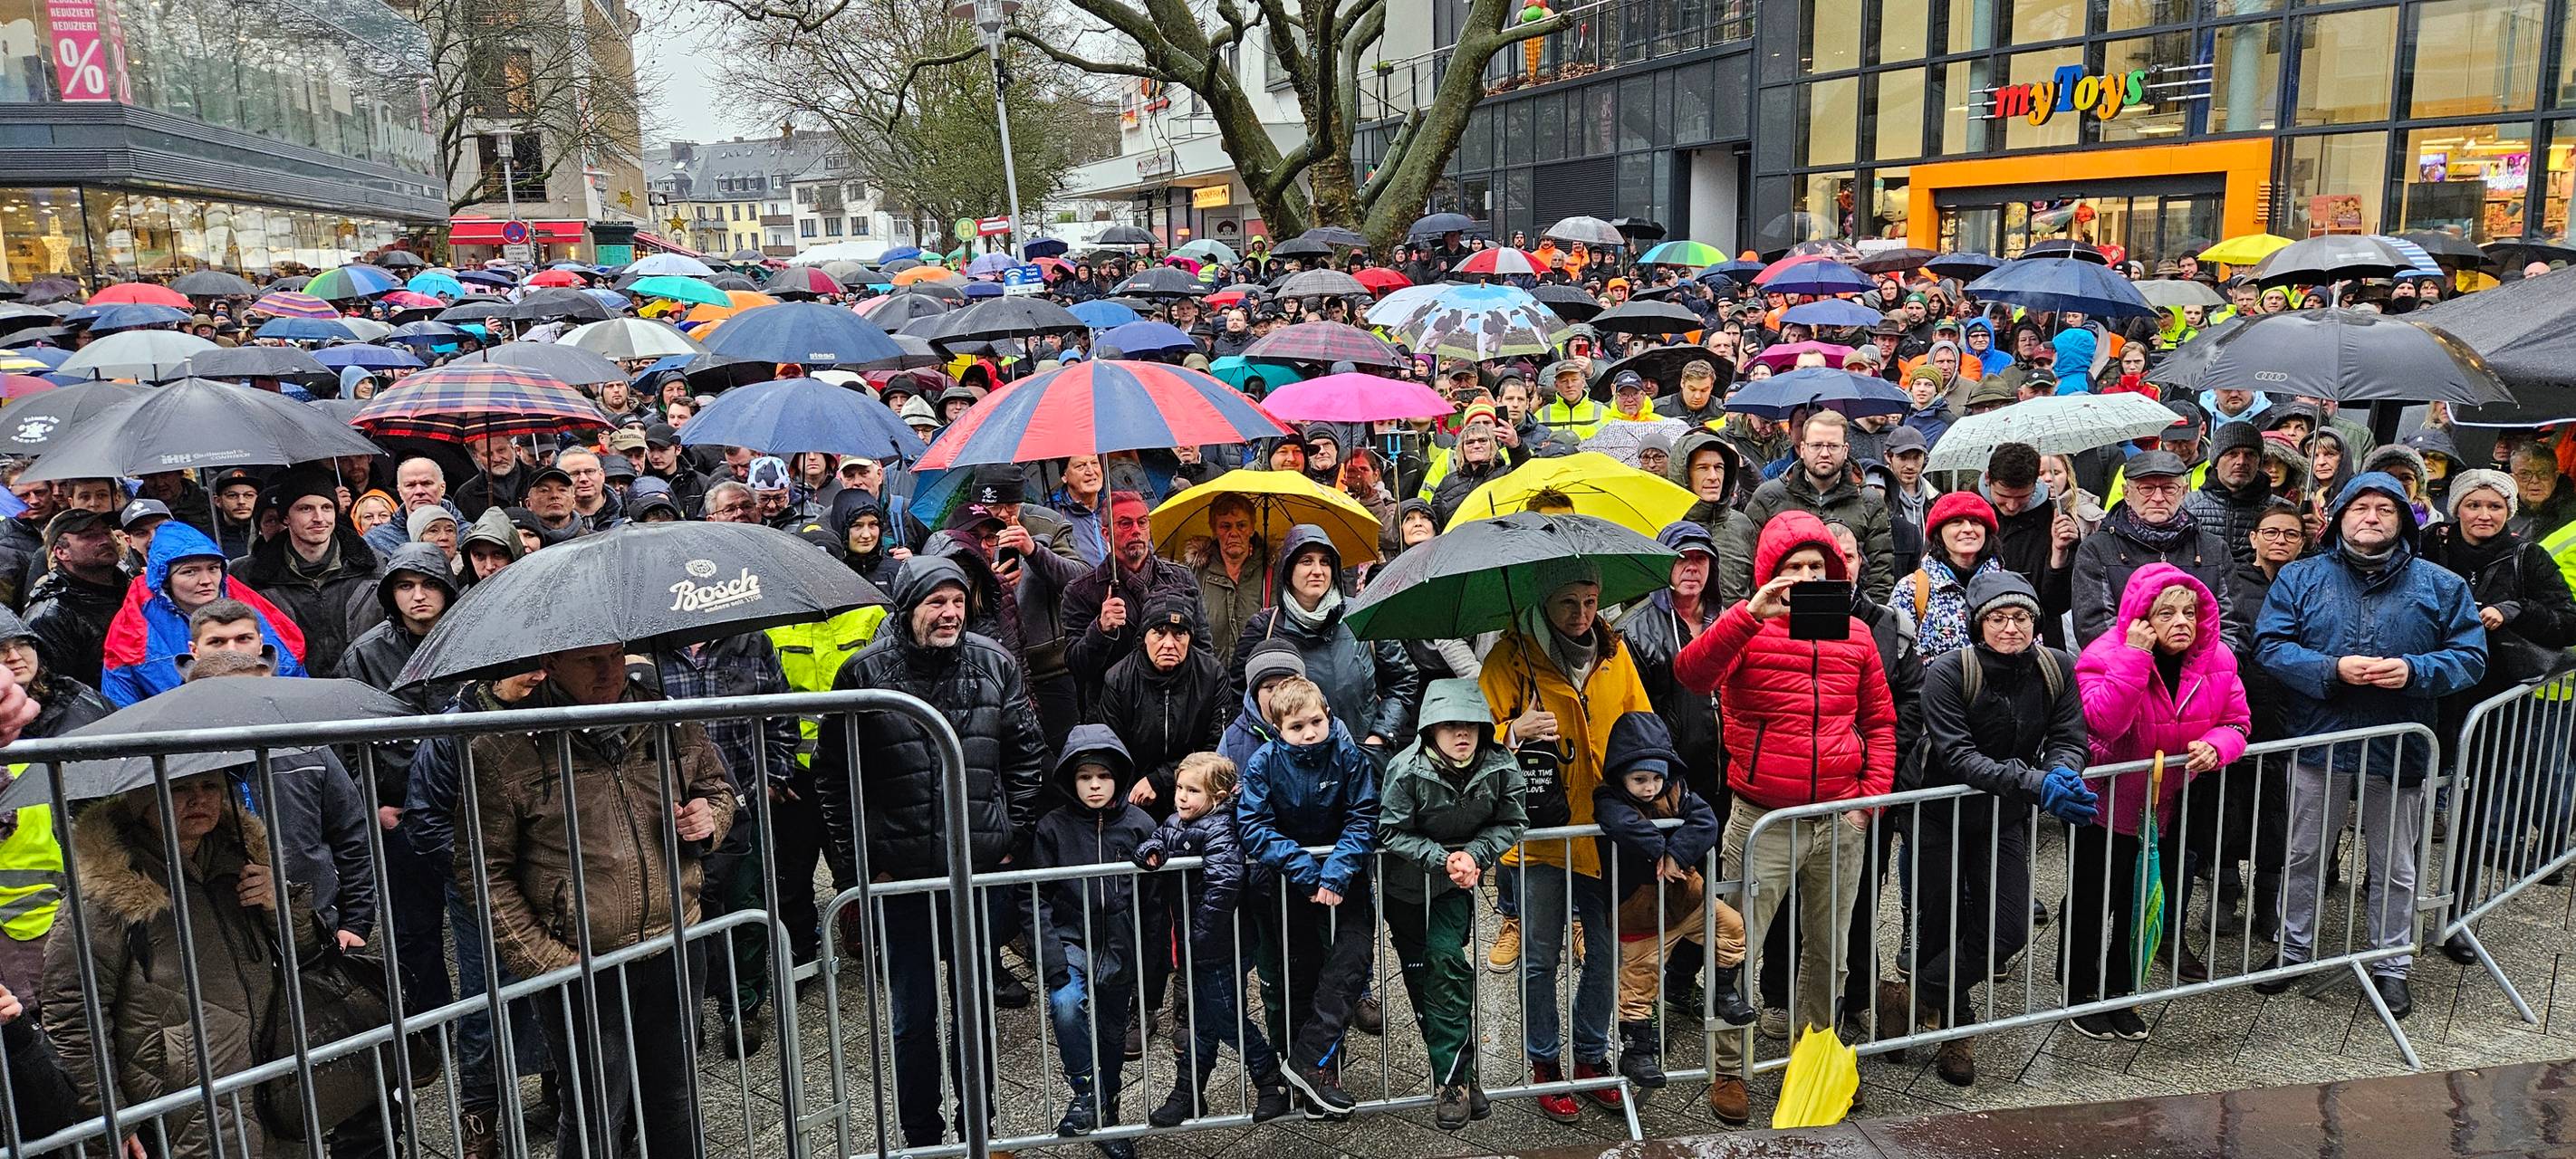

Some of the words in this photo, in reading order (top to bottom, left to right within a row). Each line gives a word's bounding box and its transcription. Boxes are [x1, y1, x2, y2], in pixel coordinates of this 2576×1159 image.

[49, 7, 95, 18] REDUZIERT
[52, 20, 98, 31] REDUZIERT
[59, 38, 105, 94] %
[1994, 63, 2145, 126] myToys
[961, 222, 970, 235] H
[668, 567, 761, 612] Bosch
[1538, 768, 1553, 777] TIME
[1530, 777, 1552, 786] THINGS
